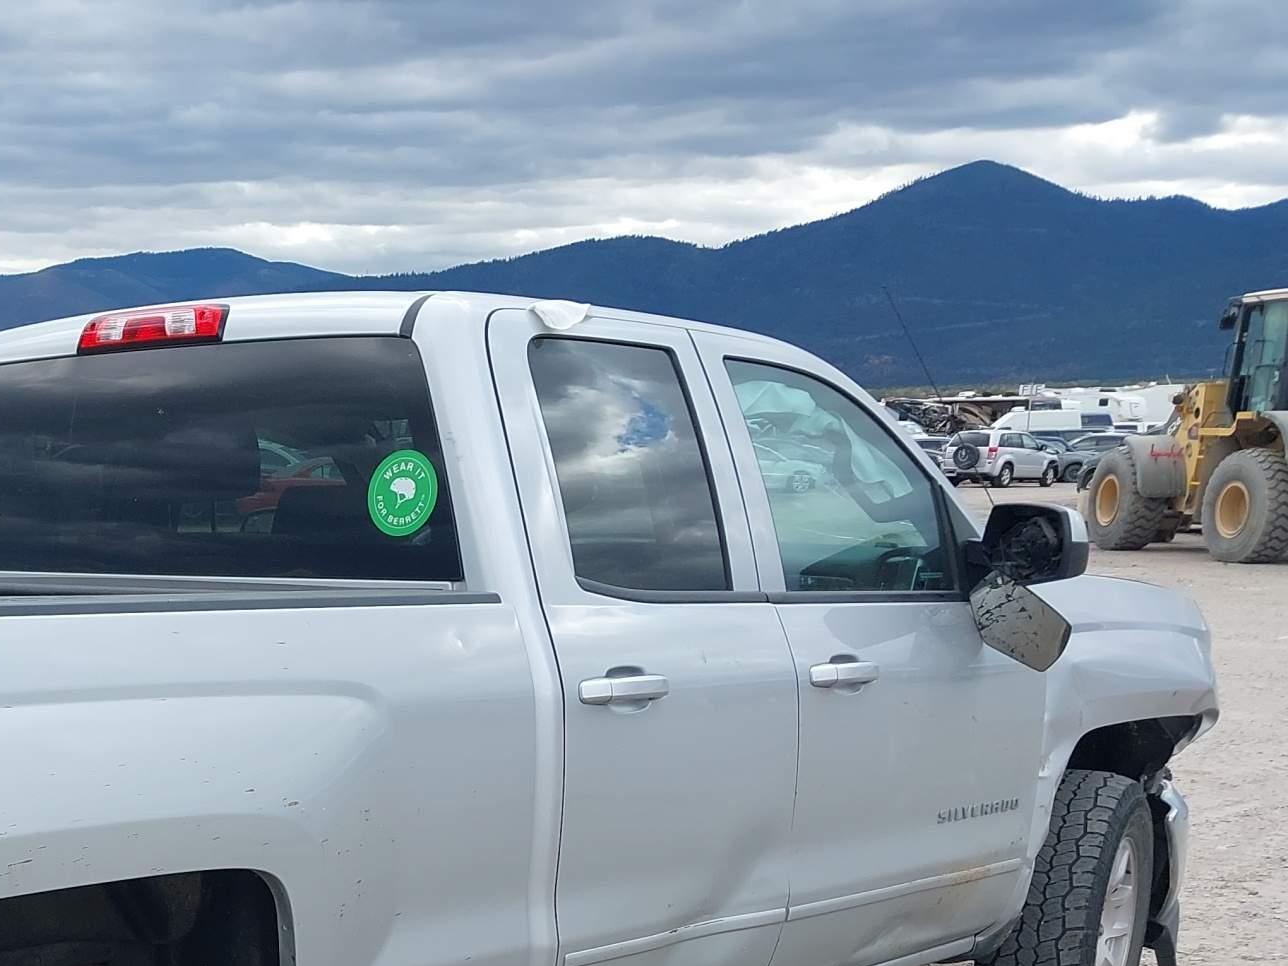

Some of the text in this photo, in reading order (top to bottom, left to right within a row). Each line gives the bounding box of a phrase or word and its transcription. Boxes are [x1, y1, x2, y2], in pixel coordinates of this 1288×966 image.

[383, 461, 426, 480] WEAR IT
[376, 495, 425, 526] FOR BERRETT
[936, 797, 1020, 825] SILVERADO
